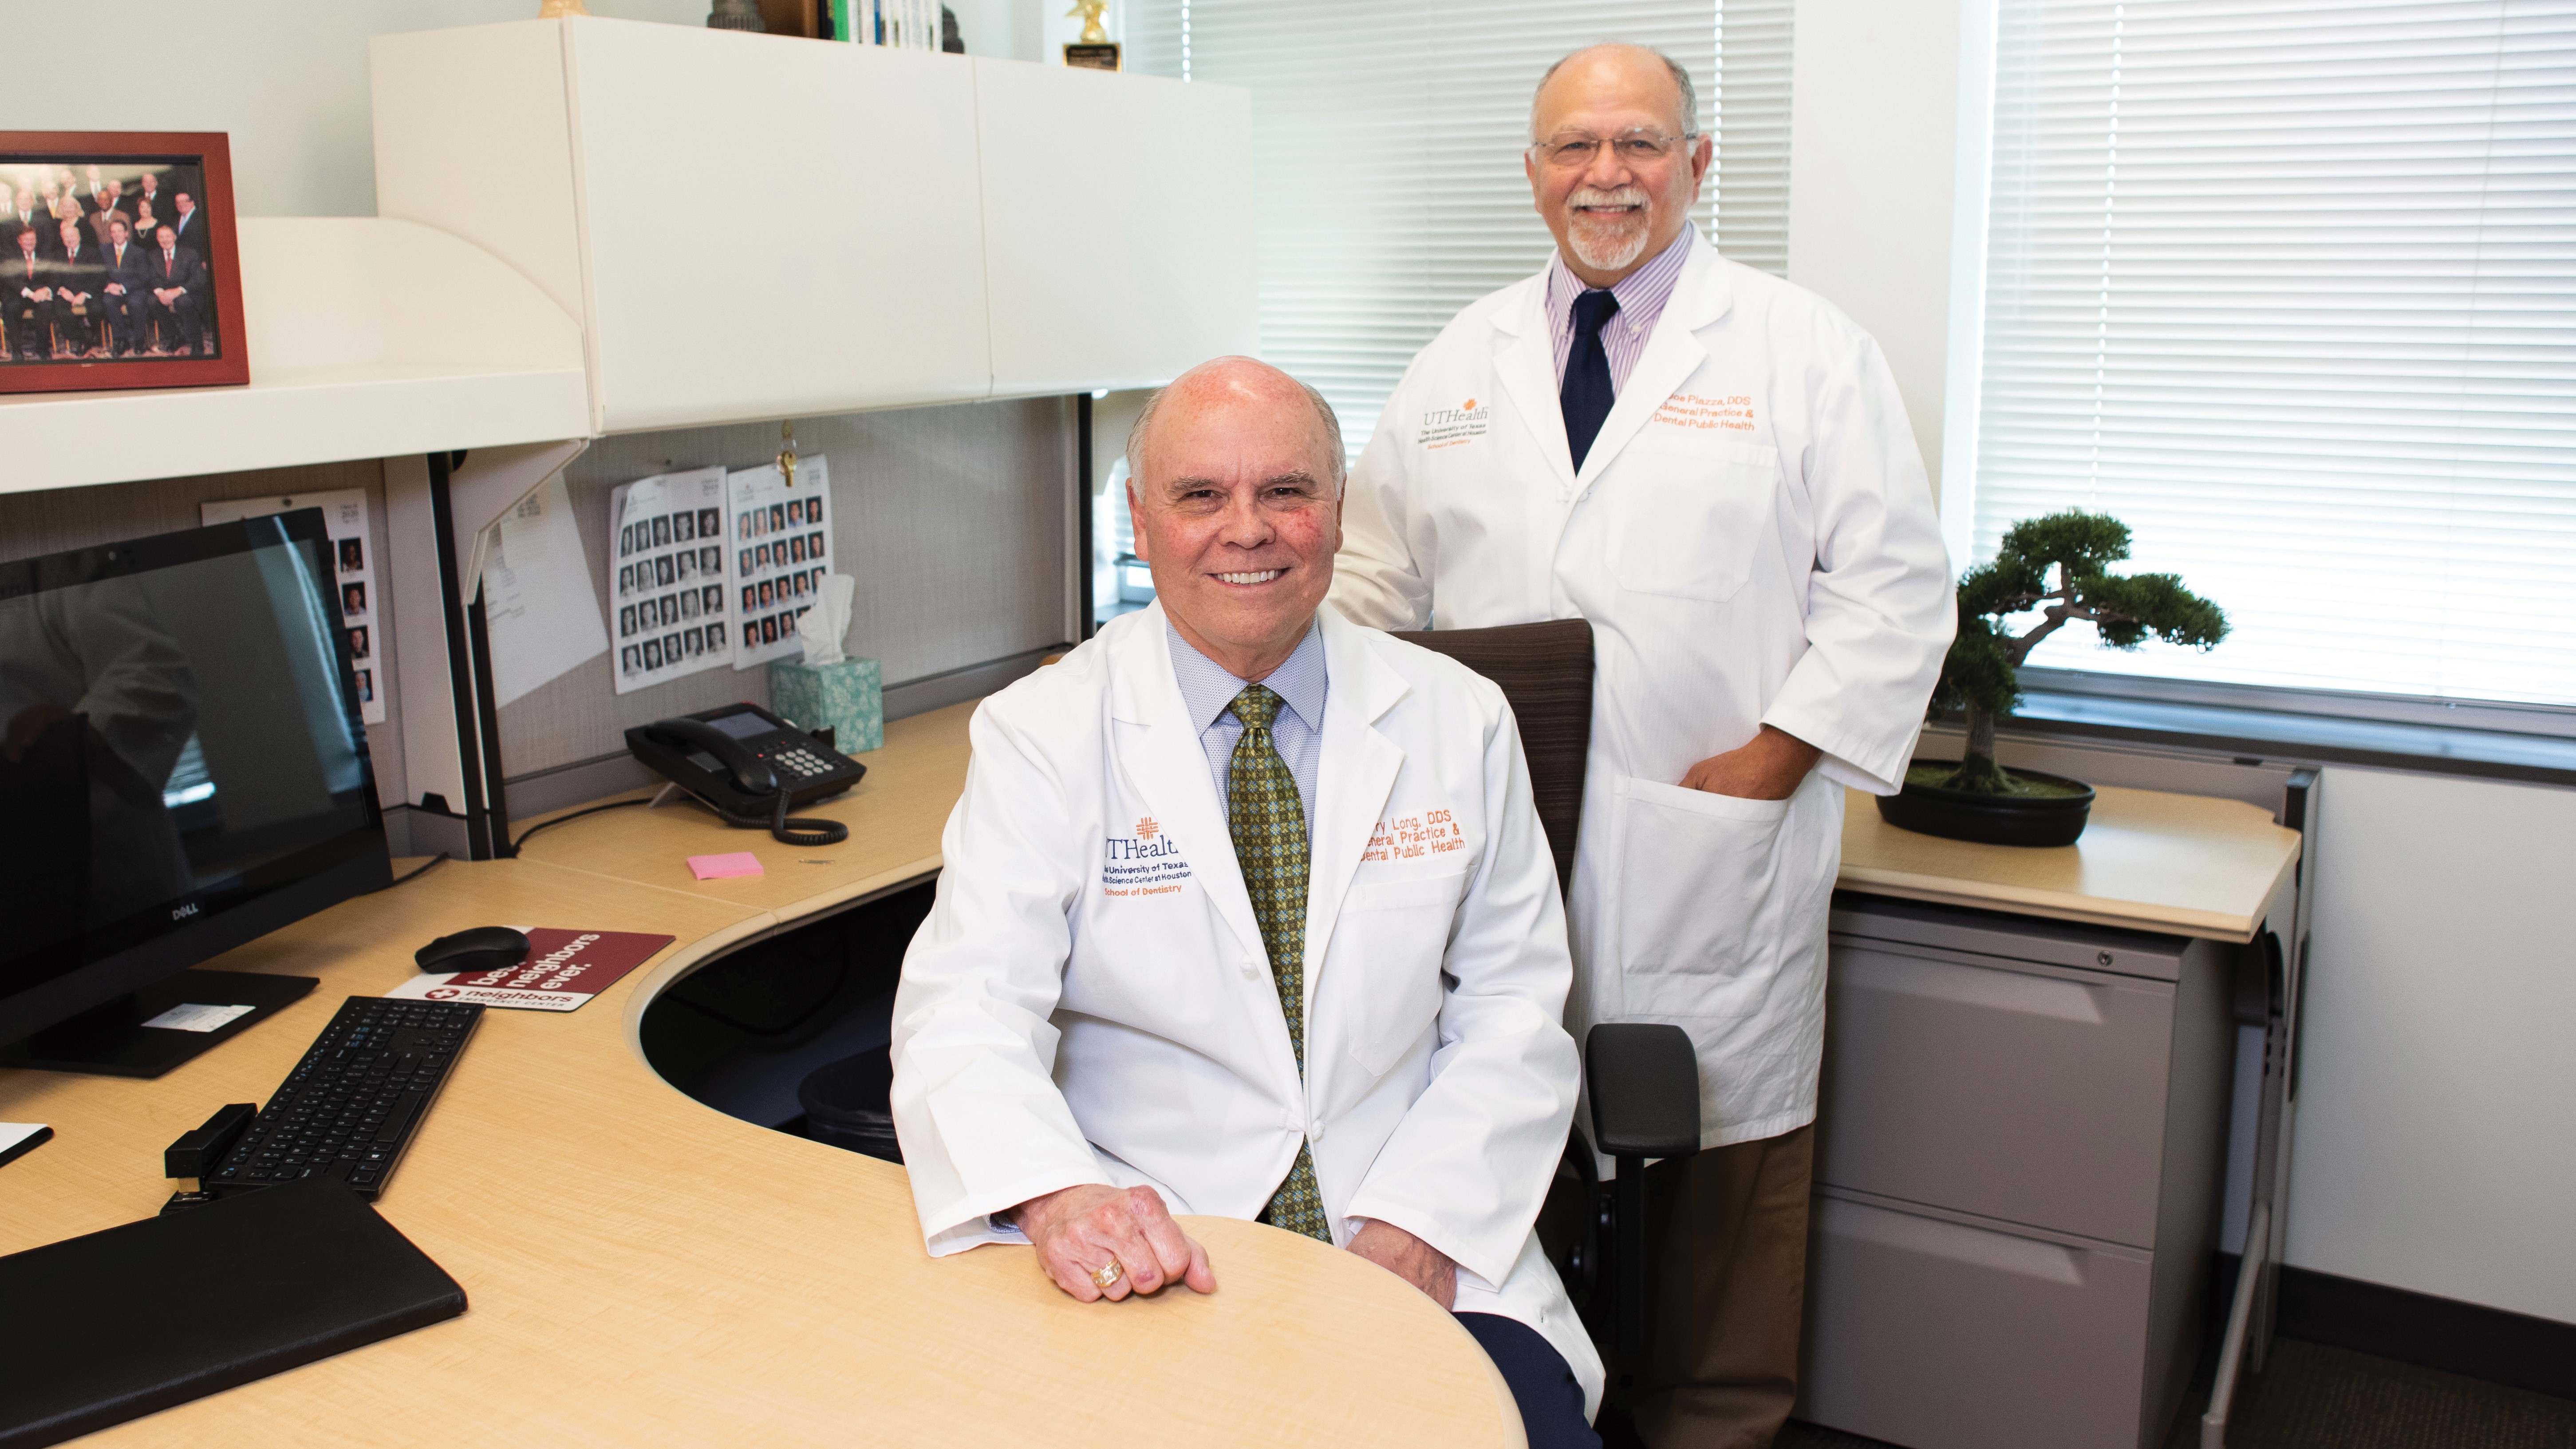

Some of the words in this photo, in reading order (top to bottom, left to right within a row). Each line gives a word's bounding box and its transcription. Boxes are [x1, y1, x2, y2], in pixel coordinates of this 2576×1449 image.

[1688, 394, 1725, 406] Piazza,
[1727, 396, 1752, 406] DDS
[1424, 407, 1488, 426] UTHealth
[1660, 402, 1699, 416] General
[1700, 407, 1743, 417] Practice
[1745, 409, 1754, 419] &
[1432, 425, 1460, 434] University
[1654, 413, 1686, 426] Dental
[1688, 419, 1719, 429] Public
[1720, 420, 1755, 431] Health
[1392, 817, 1421, 831] Long,
[1427, 809, 1452, 825] DDS
[1400, 827, 1446, 844] Practice
[1452, 822, 1460, 836] &
[1105, 835, 1179, 860] THealt
[1394, 844, 1425, 859] Public
[1431, 837, 1466, 854] Health
[1109, 864, 1149, 874] University
[1152, 863, 1160, 872] of
[1109, 875, 1133, 885] Science
[1161, 870, 1192, 880] Houston
[1105, 887, 1128, 896] School
[1131, 887, 1140, 896] of
[1142, 885, 1182, 895] Dentistry
[172, 902, 199, 921] DELL
[506, 933, 600, 988] neighbors
[540, 963, 592, 990] ever.
[465, 990, 574, 1003] neighbors
